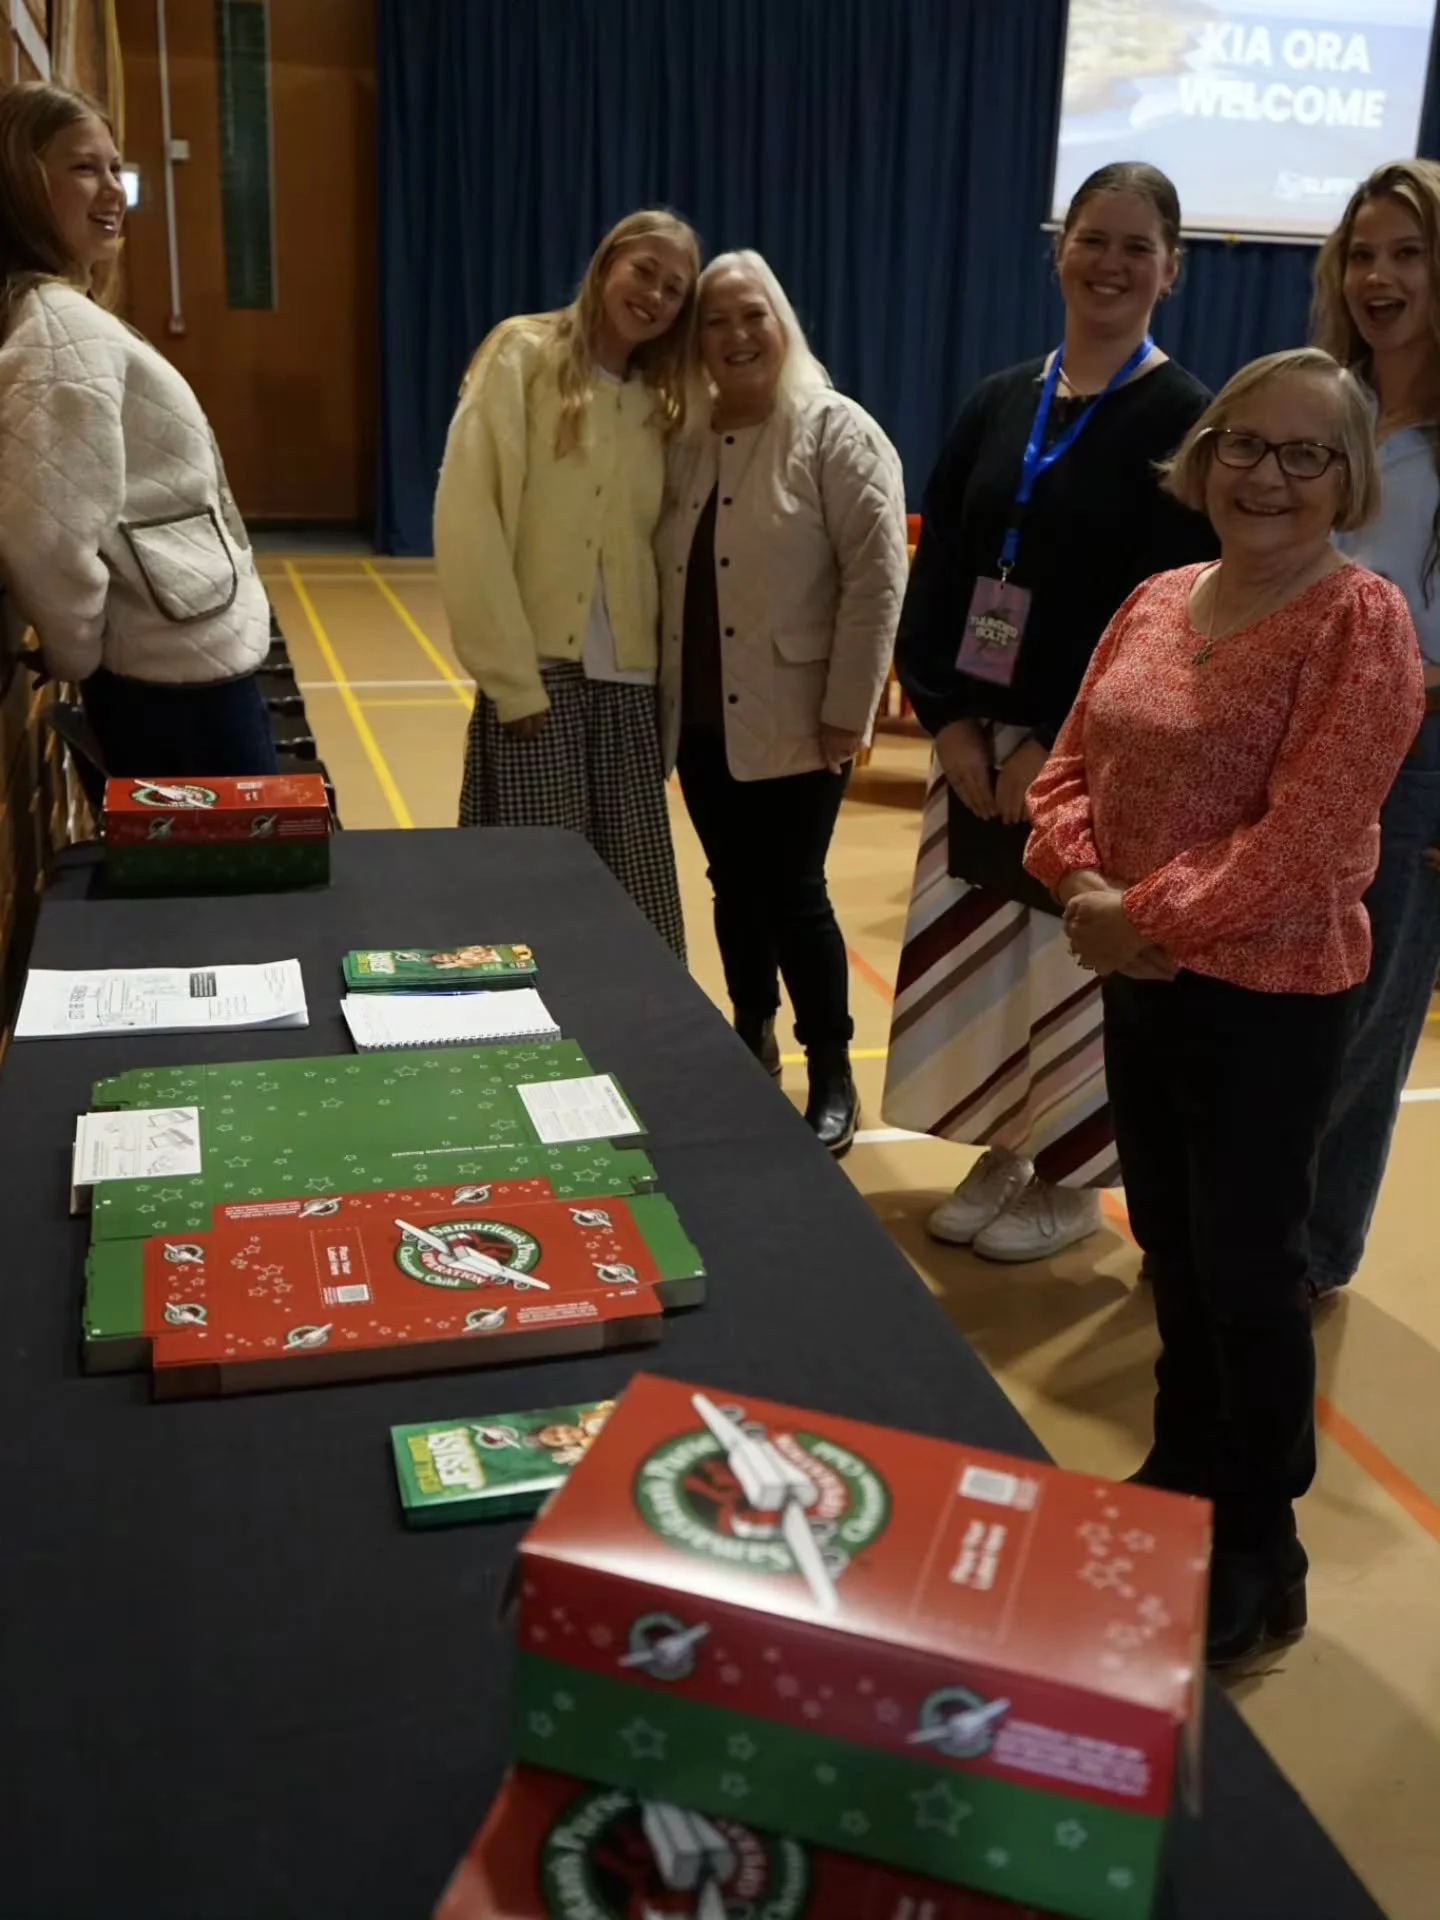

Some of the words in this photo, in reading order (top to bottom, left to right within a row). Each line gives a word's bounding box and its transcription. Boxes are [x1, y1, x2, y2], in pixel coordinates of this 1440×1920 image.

[1200, 22, 1272, 68] KIA
[1283, 28, 1371, 74] ORA
[1179, 75, 1387, 129] WELCOME
[428, 1222, 527, 1244] Samaritan's
[425, 1274, 460, 1287] Child
